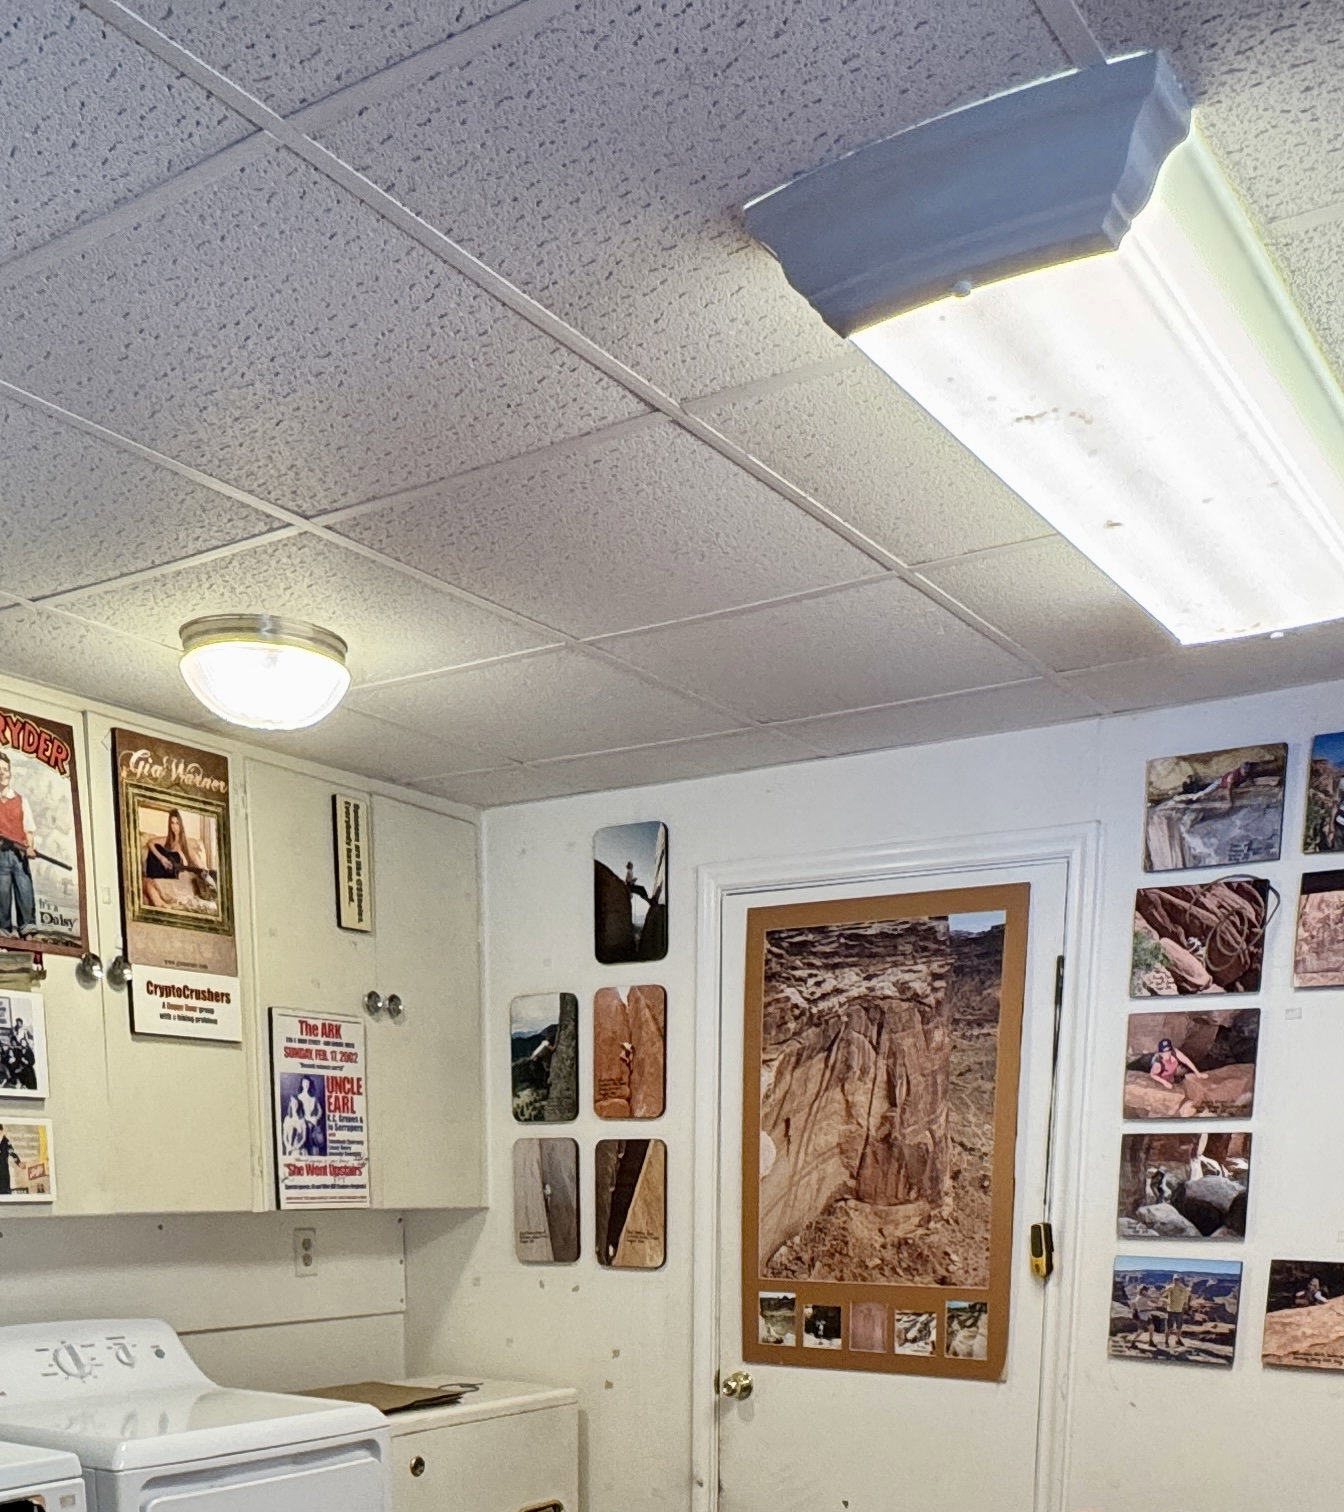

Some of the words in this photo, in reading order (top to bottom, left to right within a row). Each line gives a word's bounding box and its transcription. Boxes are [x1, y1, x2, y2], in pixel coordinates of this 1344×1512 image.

[40, 911, 78, 932] Daisy
[146, 980, 232, 1005] CryptoCrushers
[298, 1019, 319, 1038] The
[321, 1022, 343, 1040] ARK
[326, 1075, 363, 1096] UNCLE
[327, 1095, 357, 1114] EARL
